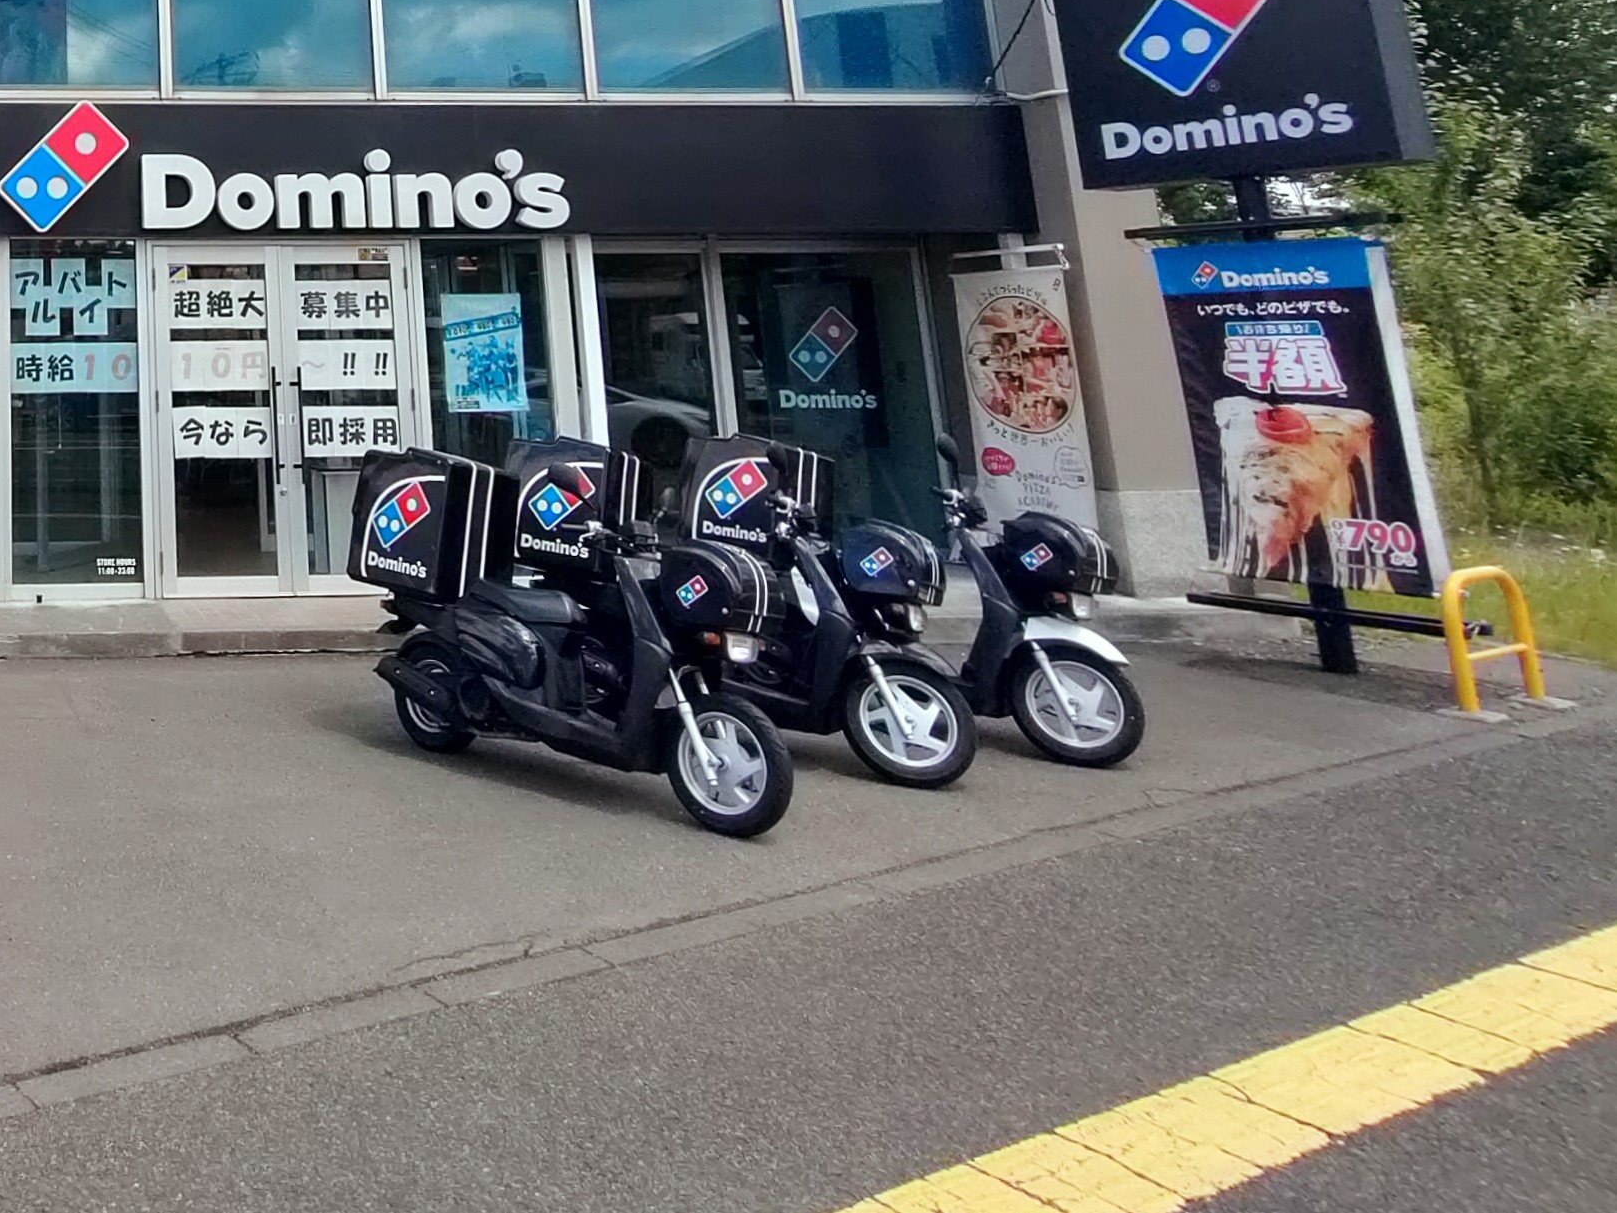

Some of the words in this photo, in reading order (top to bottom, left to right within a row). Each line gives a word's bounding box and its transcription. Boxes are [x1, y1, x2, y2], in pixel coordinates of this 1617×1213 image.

[1100, 93, 1354, 159] Domino's
[141, 148, 571, 230] Domino's
[1220, 266, 1330, 287] Domino's
[173, 290, 265, 318] 超絶大
[300, 290, 390, 319] 募集中
[1225, 338, 1345, 390] 半額
[779, 389, 877, 408] Domino's
[702, 520, 767, 543] Domino's
[520, 533, 589, 558] Domino's
[96, 558, 115, 566] STORE
[367, 551, 427, 578] Domino's
